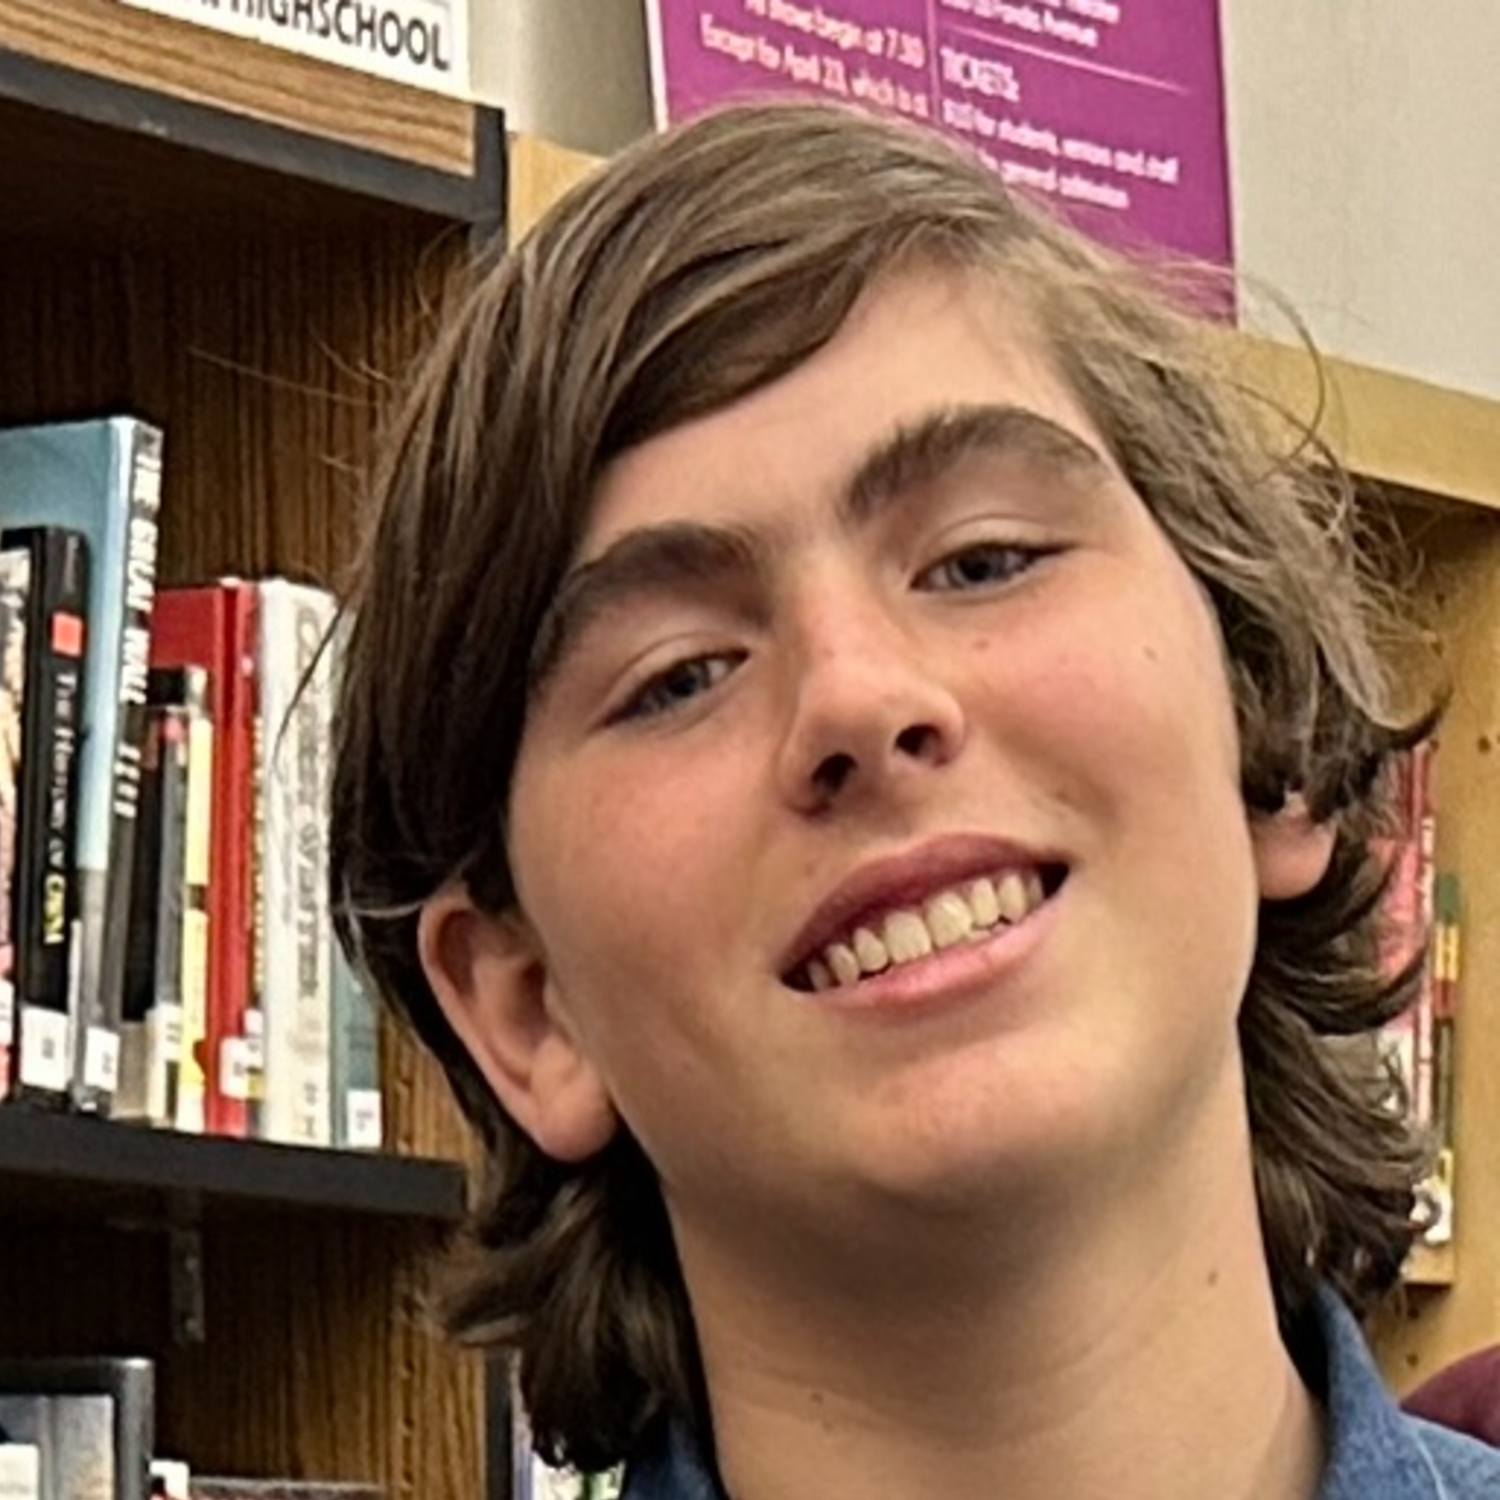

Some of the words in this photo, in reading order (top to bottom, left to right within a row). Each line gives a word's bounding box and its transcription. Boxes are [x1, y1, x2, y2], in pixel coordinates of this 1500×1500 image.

[134, 453, 162, 513] THE
[127, 517, 158, 614] GREAT
[119, 627, 150, 705] WALL
